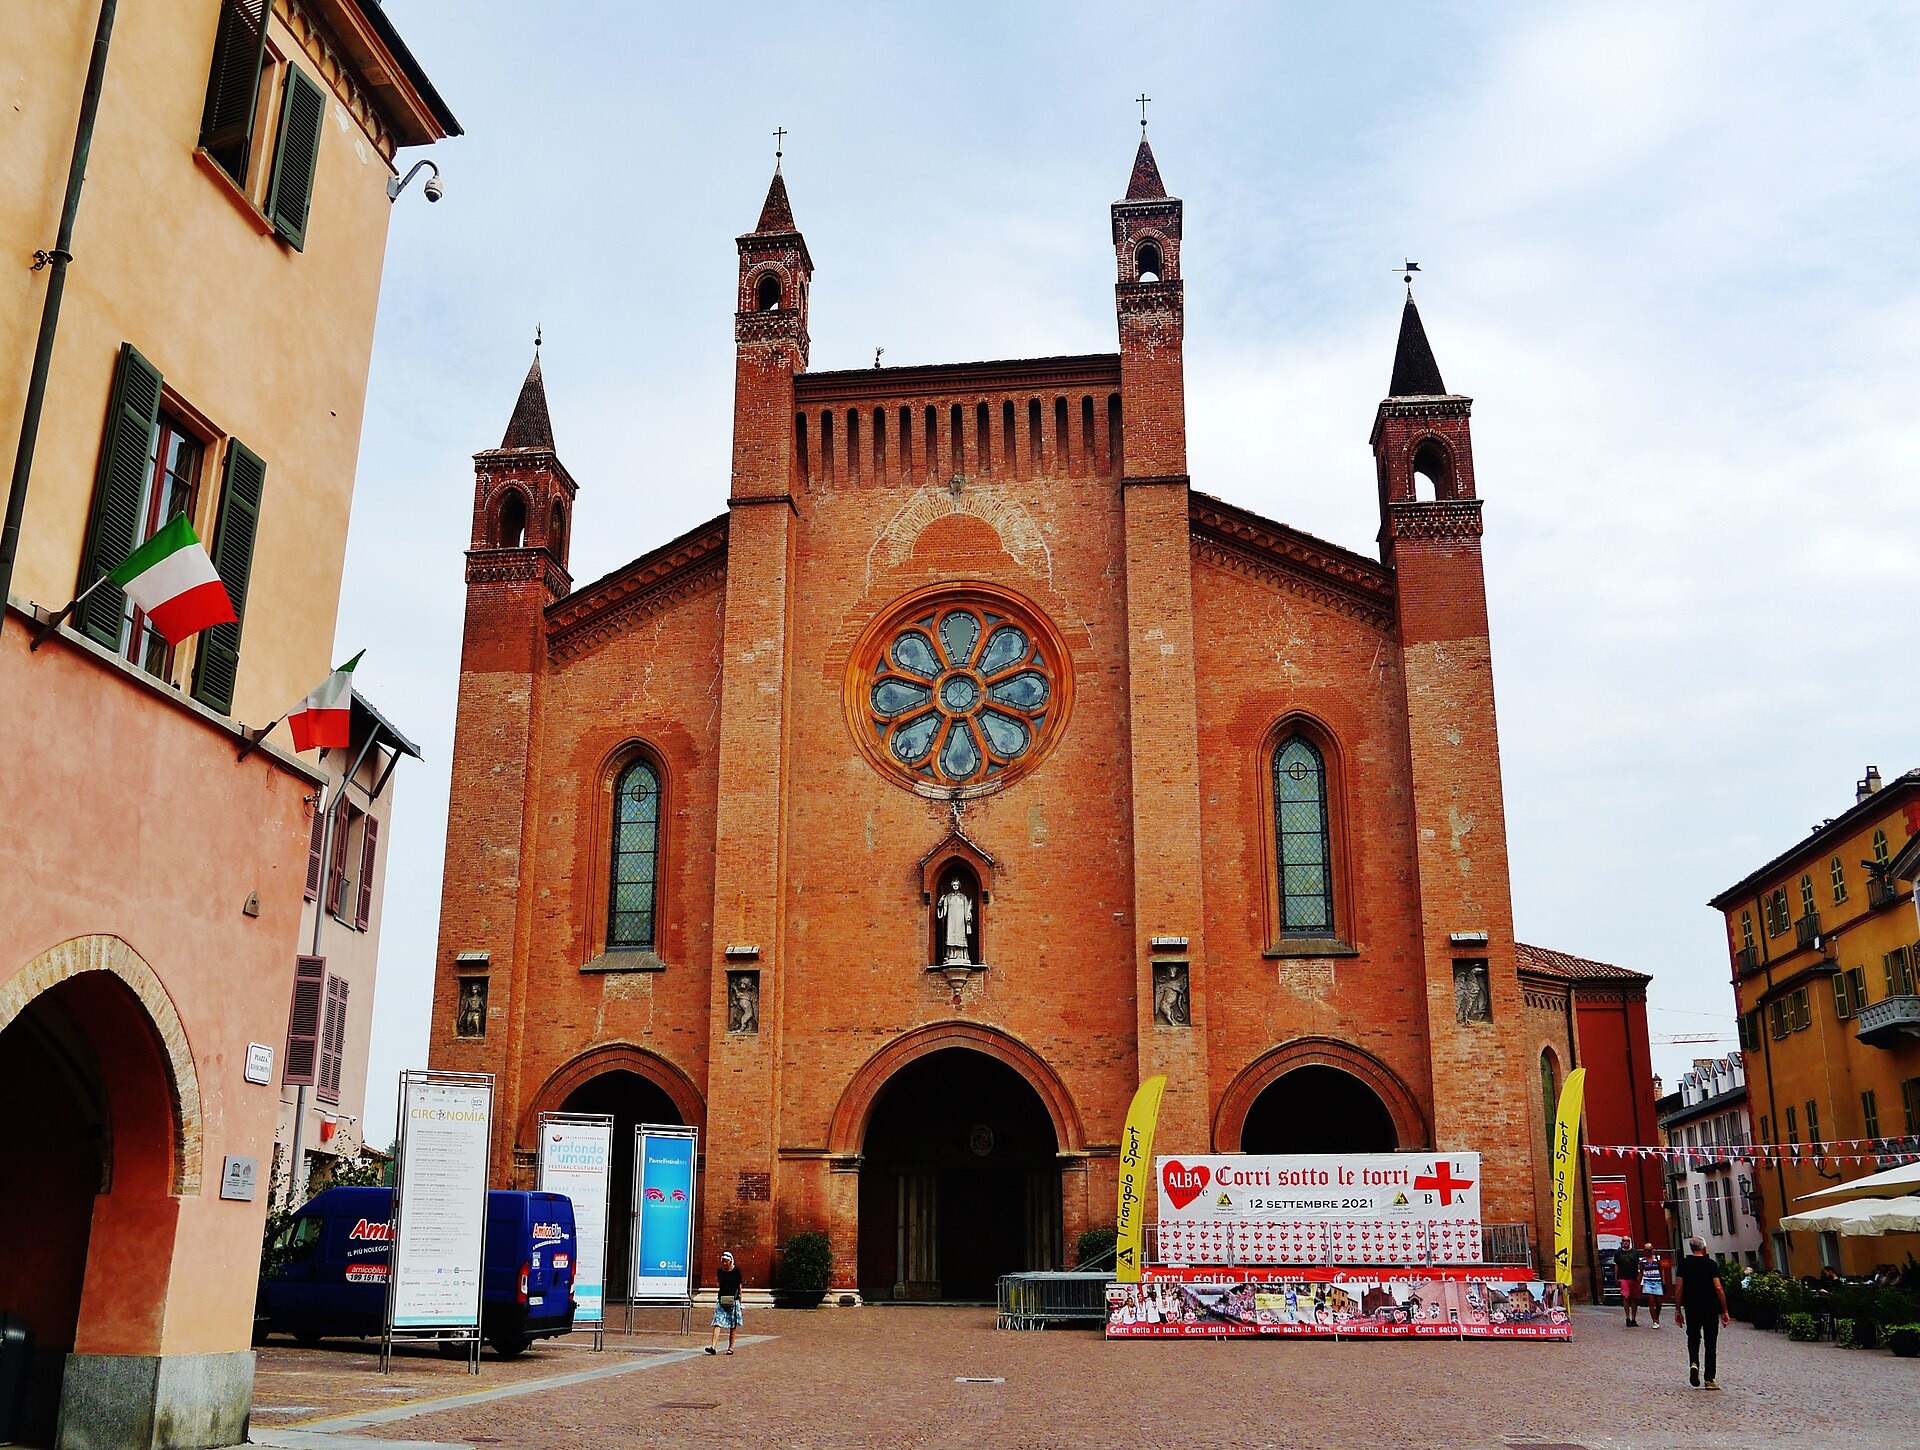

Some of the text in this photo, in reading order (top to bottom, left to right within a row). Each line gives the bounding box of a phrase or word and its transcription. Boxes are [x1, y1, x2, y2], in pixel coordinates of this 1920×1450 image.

[1123, 1126, 1141, 1168] Sport
[1556, 1121, 1571, 1164] Sport
[550, 1141, 604, 1157] profondo
[558, 1154, 604, 1165] umano
[1168, 1172, 1203, 1188] ALBA
[1215, 1165, 1409, 1187] Corri sotto le torri
[1249, 1198, 1374, 1209] 12 SETTEMBRE 2021
[364, 1245, 393, 1254] NOLEGGI
[1109, 1325, 1129, 1334] Corri
[1132, 1325, 1151, 1334] sotto
[1185, 1326, 1205, 1334] Corri
[1207, 1325, 1226, 1333] sotto
[1260, 1325, 1280, 1334] Corri
[1283, 1325, 1302, 1333] sotto
[1336, 1325, 1357, 1333] Corri
[1360, 1325, 1379, 1333] sotto
[1415, 1325, 1436, 1334] Corri
[1439, 1325, 1458, 1333] sotto
[1493, 1326, 1515, 1335] Corri
[1517, 1327, 1537, 1335] sotto
